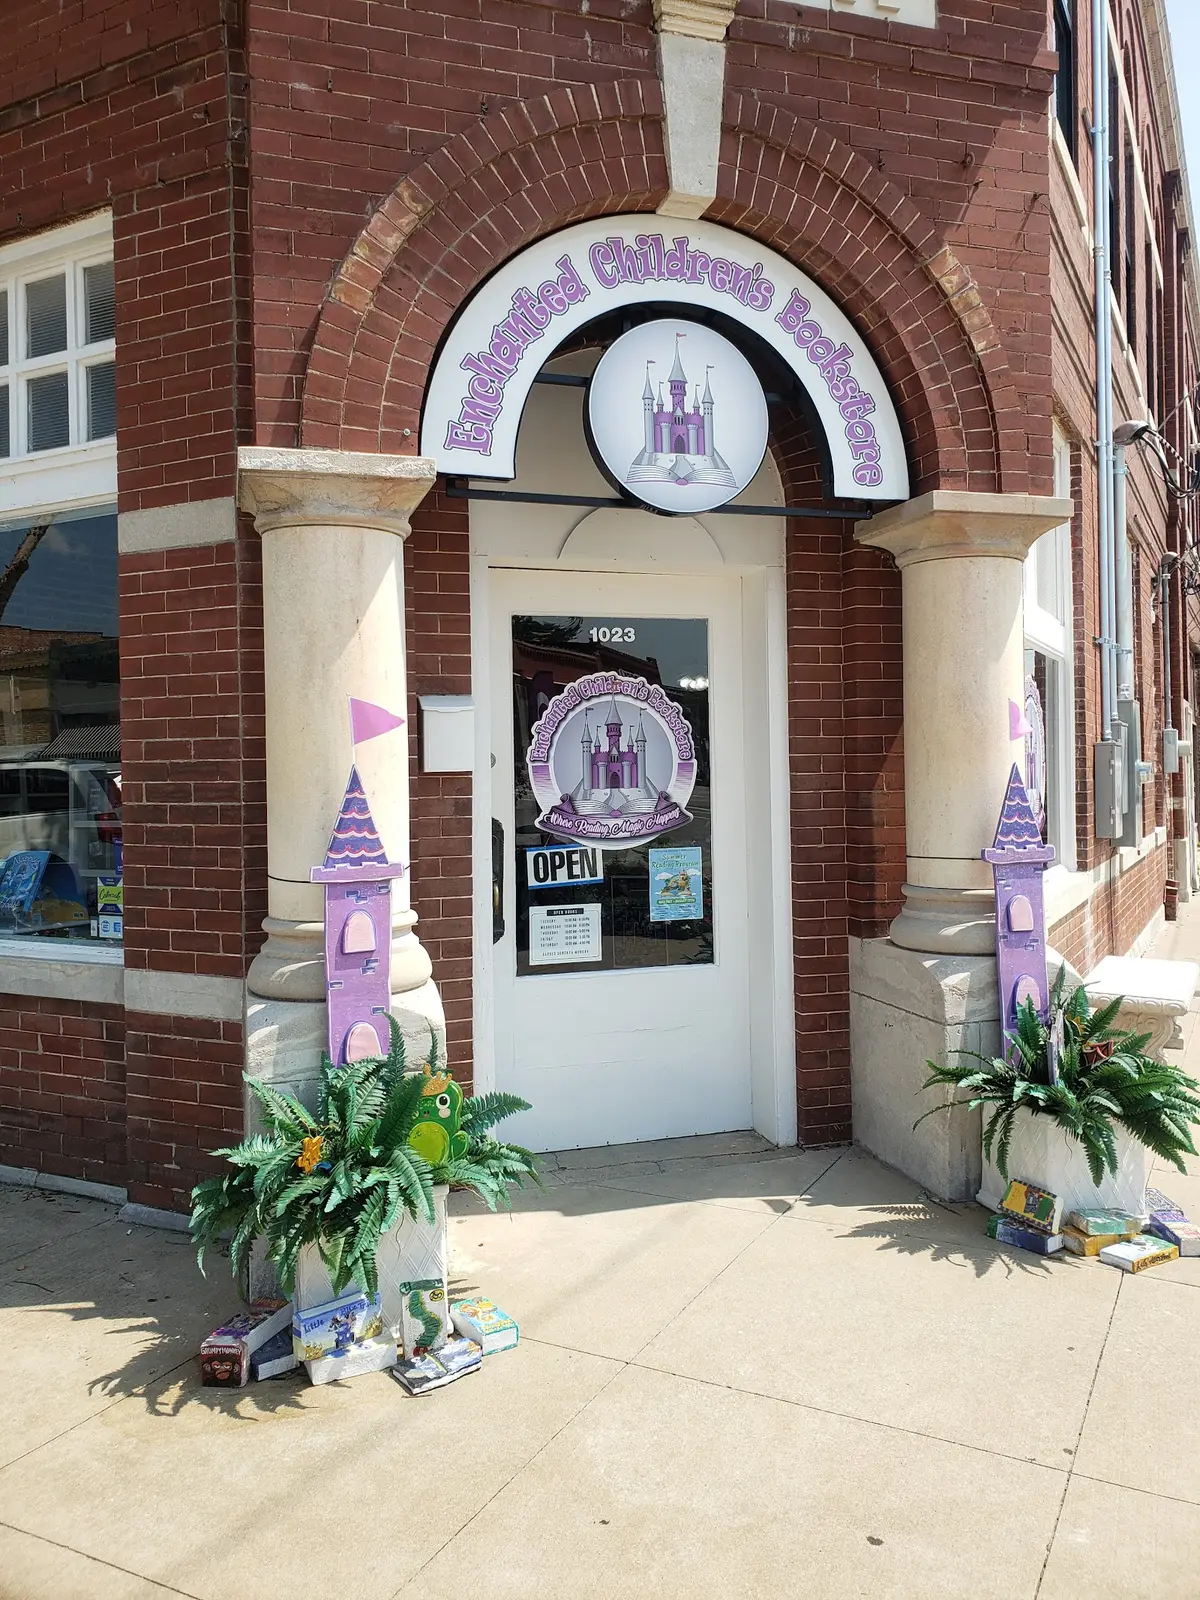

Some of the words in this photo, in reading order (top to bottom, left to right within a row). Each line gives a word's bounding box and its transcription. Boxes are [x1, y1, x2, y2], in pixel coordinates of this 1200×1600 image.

[443, 254, 591, 457] Enchanted
[588, 234, 775, 312] Children's
[777, 288, 884, 488] Bookstore
[589, 626, 636, 643] 1023
[530, 686, 582, 763] Enchanted
[578, 674, 650, 700] Children's
[648, 688, 692, 761] Bookstore
[543, 812, 573, 829] Where
[574, 818, 612, 839] Reading
[610, 820, 645, 837] Magic
[645, 808, 681, 829] Happens
[532, 850, 598, 884] OPEN
[340, 1304, 357, 1314] Blue
[303, 1319, 326, 1334] Little
[200, 1346, 221, 1355] GRUMPY
